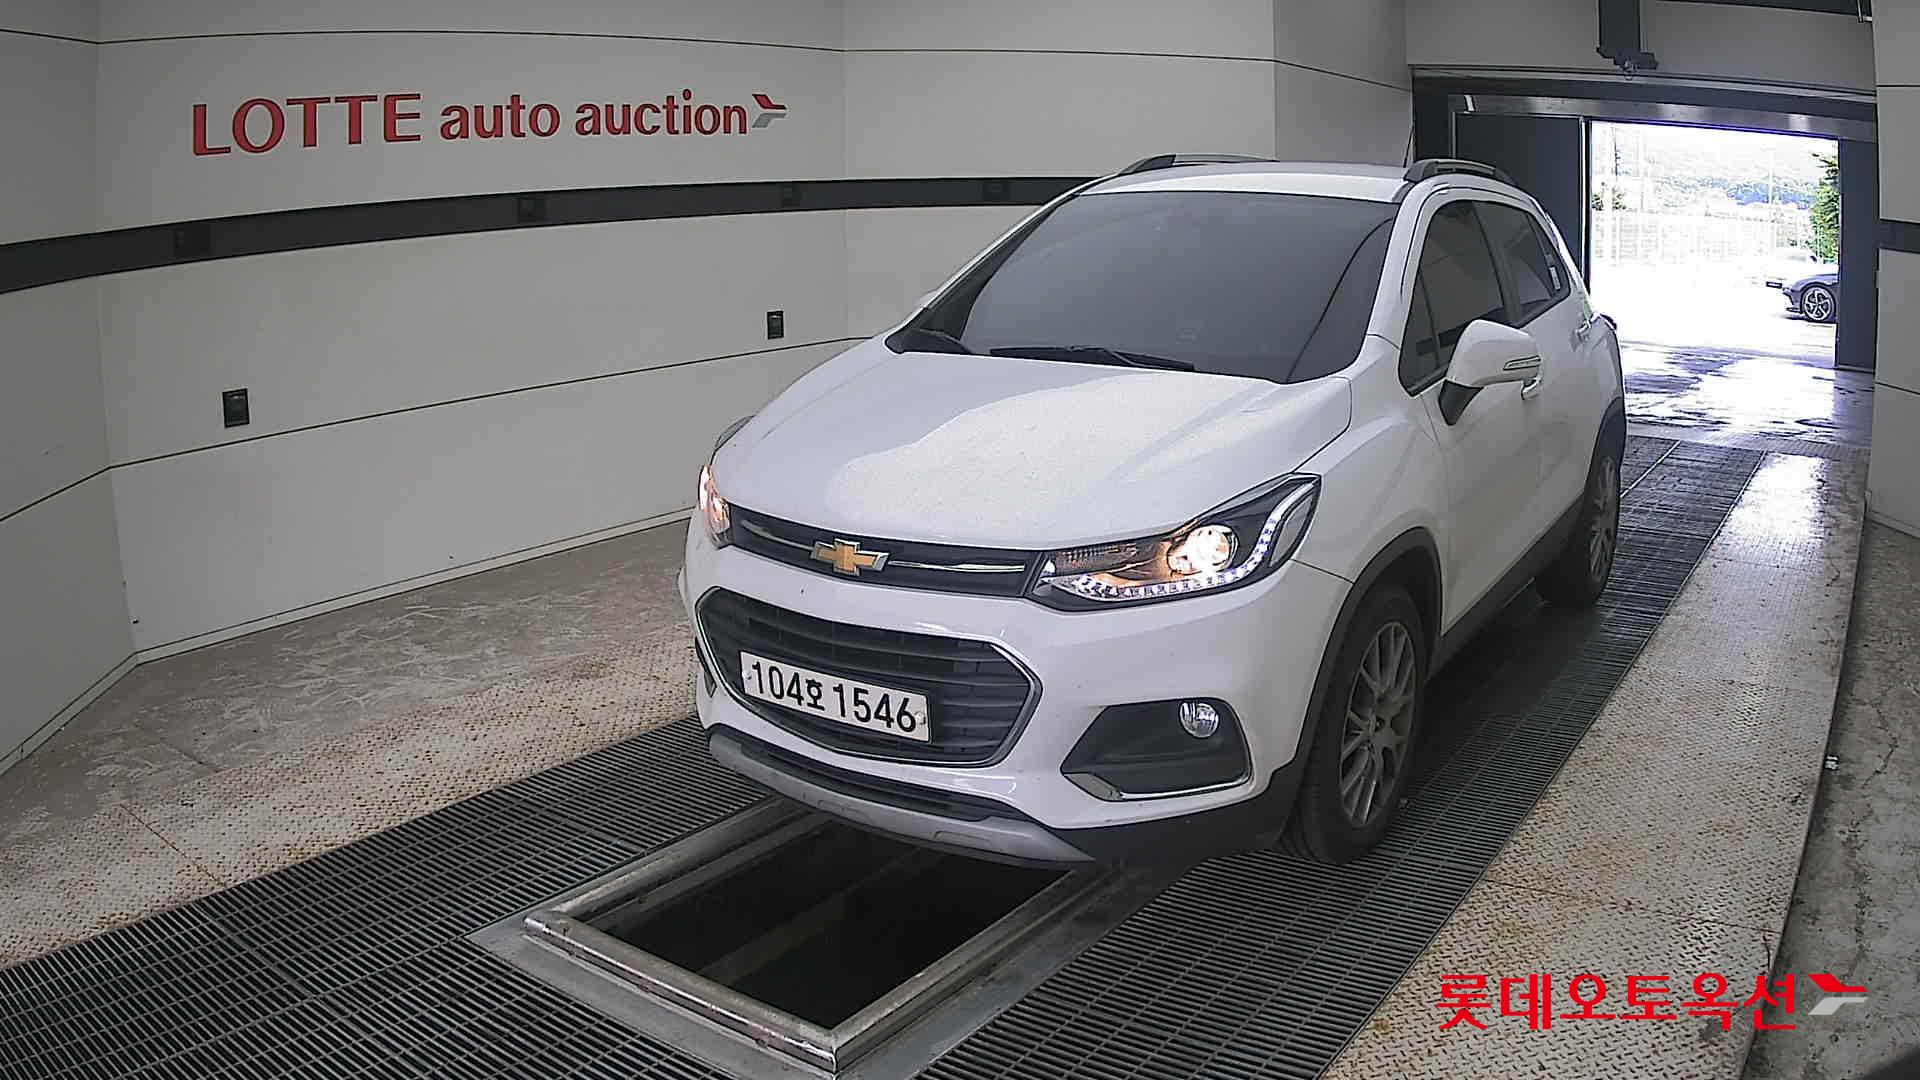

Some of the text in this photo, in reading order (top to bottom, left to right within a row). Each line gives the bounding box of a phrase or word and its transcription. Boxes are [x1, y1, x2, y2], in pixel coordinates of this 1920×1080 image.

[193, 89, 748, 156] LOTTE auto auction
[752, 661, 917, 732] 104호 1546
